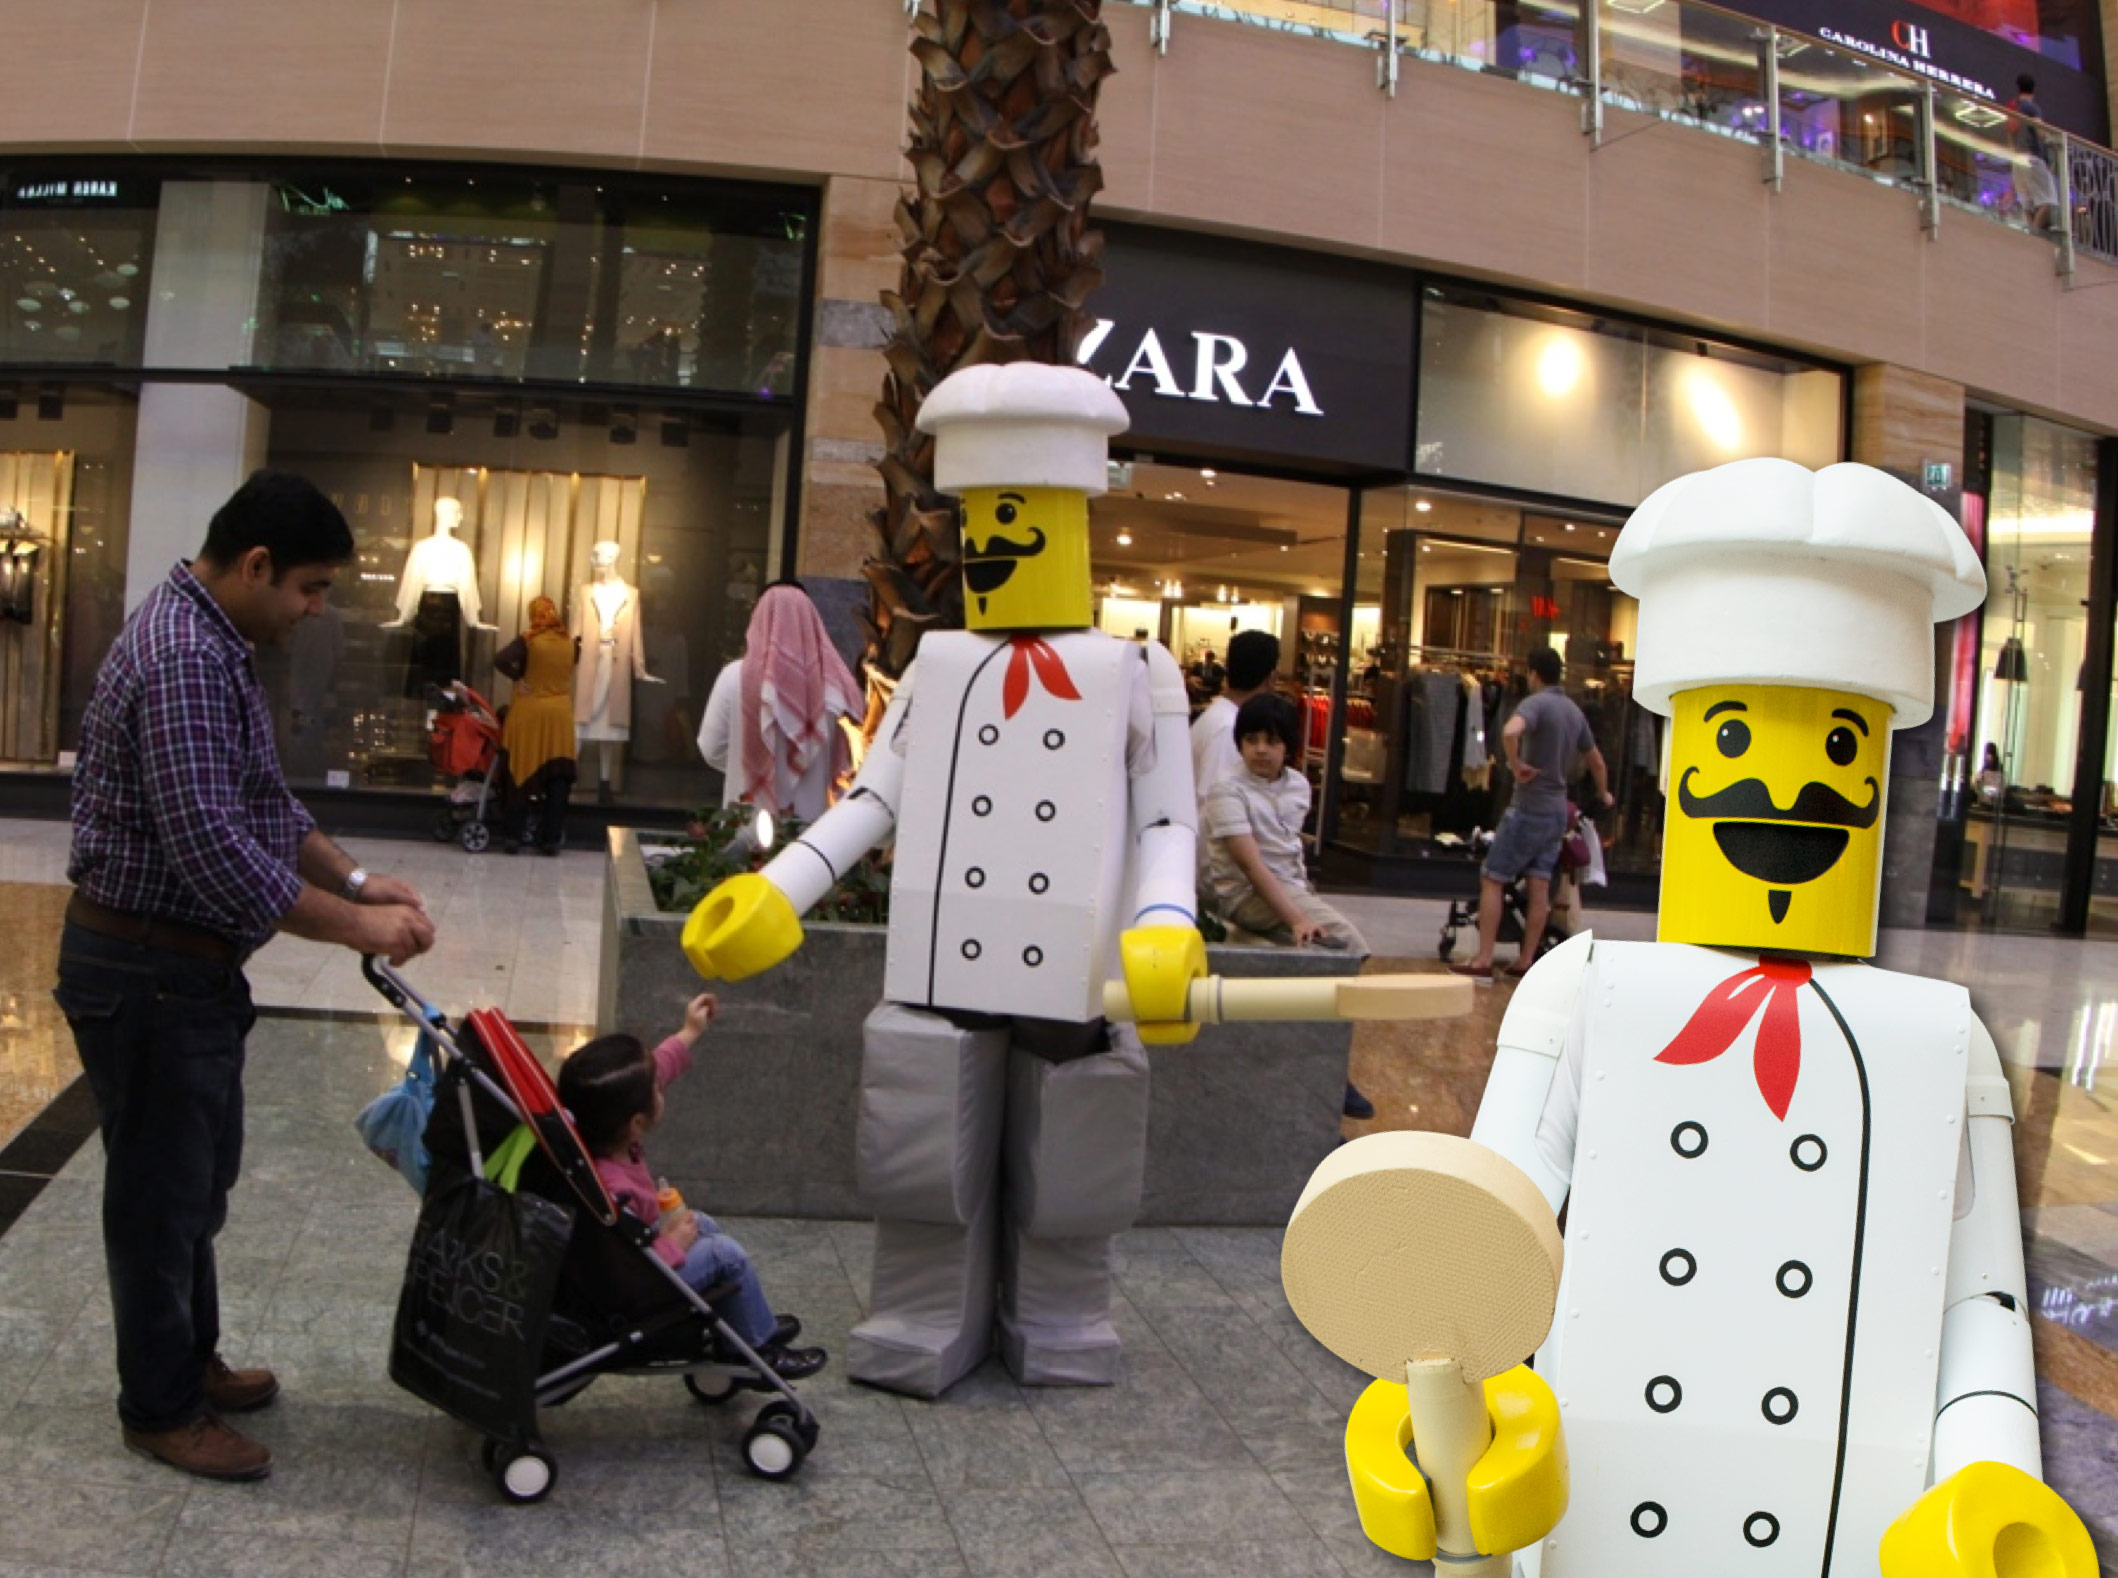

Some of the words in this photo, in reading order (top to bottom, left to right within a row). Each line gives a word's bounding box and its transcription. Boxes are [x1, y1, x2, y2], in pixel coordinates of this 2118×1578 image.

[1818, 26, 1911, 68] CAROLINA
[1912, 59, 1997, 99] HERRERA
[1890, 19, 1932, 58] CH
